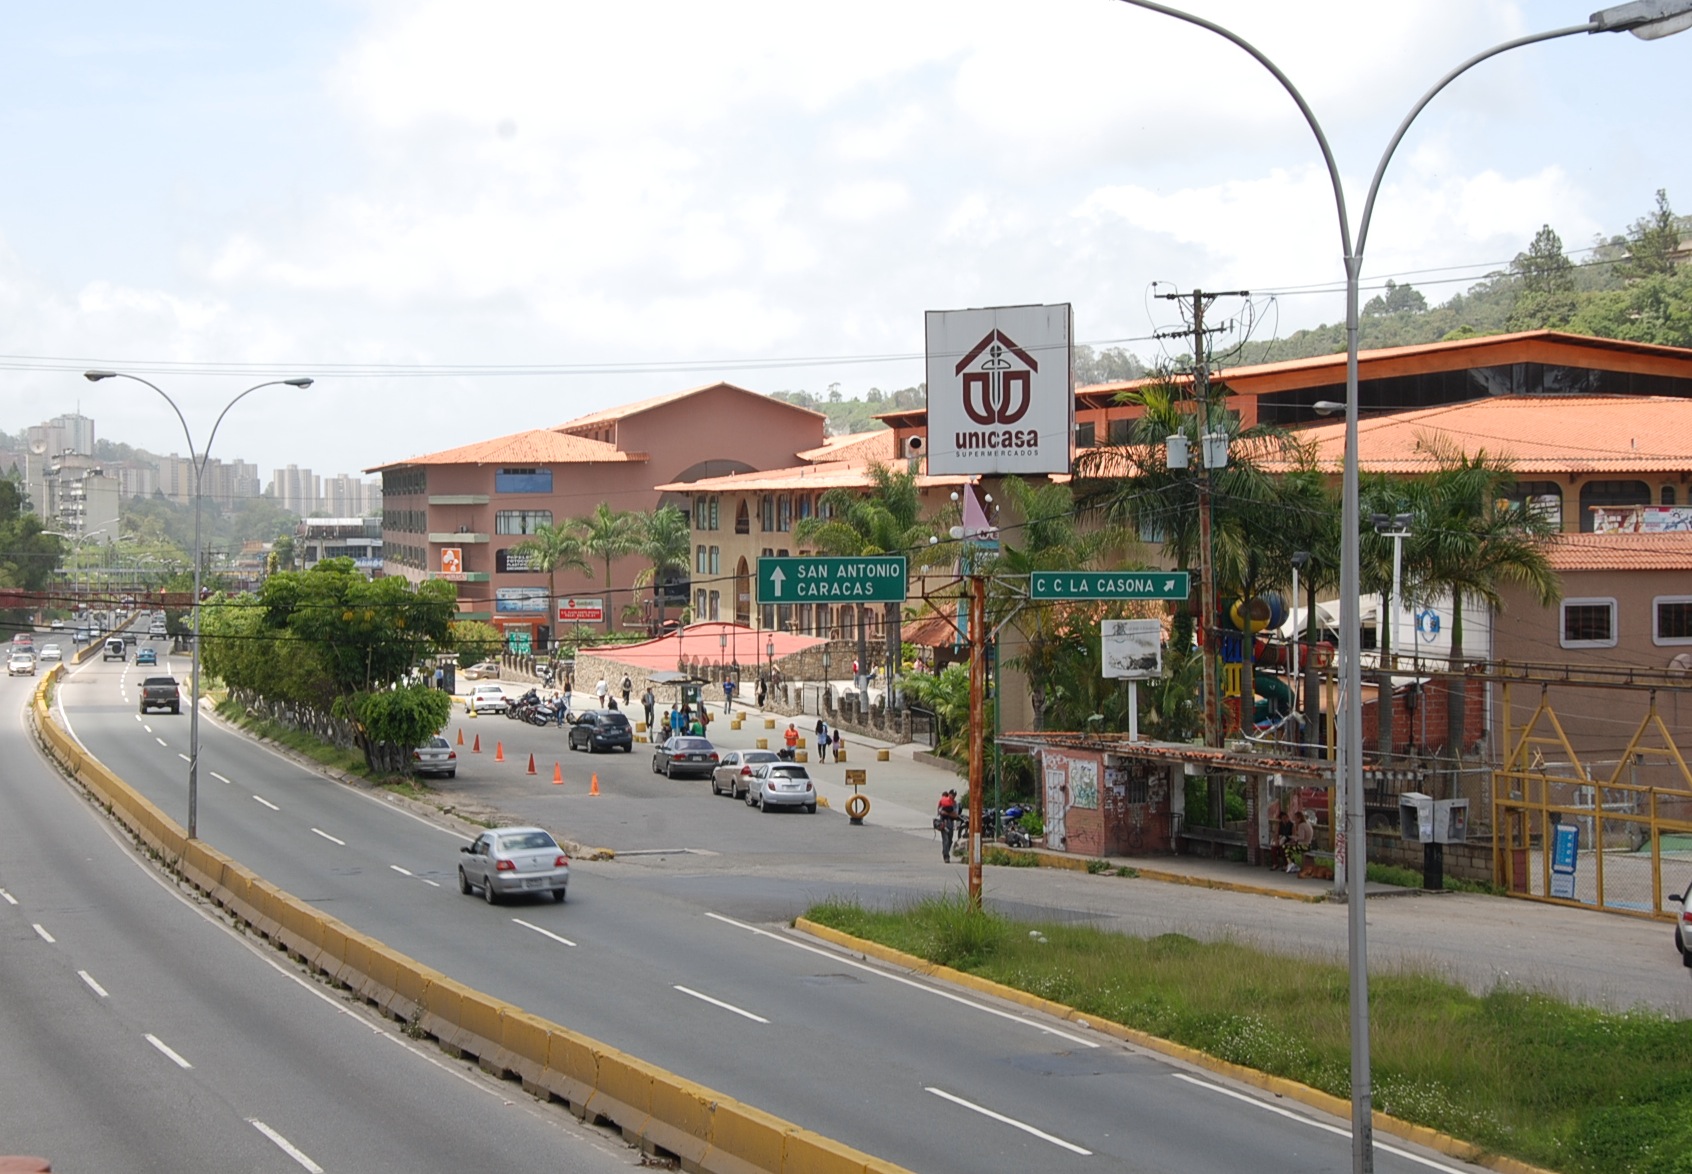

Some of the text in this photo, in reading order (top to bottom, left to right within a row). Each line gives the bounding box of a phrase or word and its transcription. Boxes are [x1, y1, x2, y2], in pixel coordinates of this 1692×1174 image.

[955, 429, 1039, 449] unicasa
[956, 449, 1039, 458] SUPERMERCADOS
[797, 563, 900, 579] SAN ANTONIO
[797, 582, 874, 596] CARACAS
[1070, 578, 1089, 592] LA
[1097, 578, 1154, 592] CASONA
